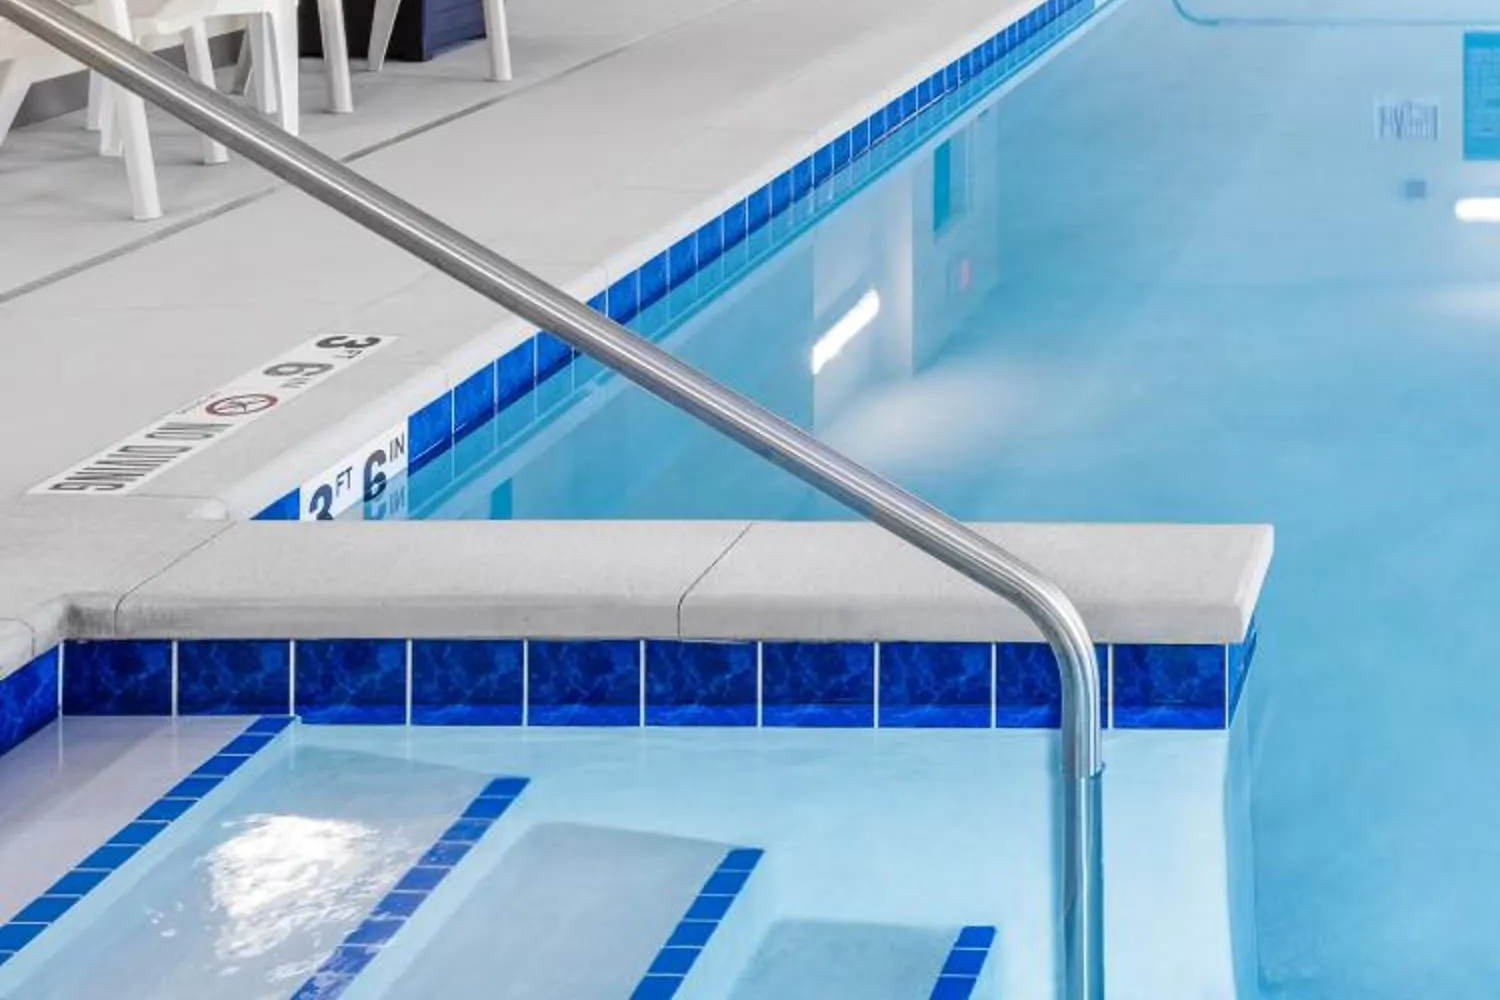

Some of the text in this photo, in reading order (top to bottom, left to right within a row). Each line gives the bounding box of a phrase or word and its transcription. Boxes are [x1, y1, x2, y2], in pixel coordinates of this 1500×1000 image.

[315, 335, 382, 351] 3
[263, 362, 334, 378] 6
[49, 421, 234, 492] NO DIVING
[309, 483, 333, 520] 3
[336, 467, 353, 496] FT
[362, 448, 387, 503] 6
[389, 432, 406, 463] IN
